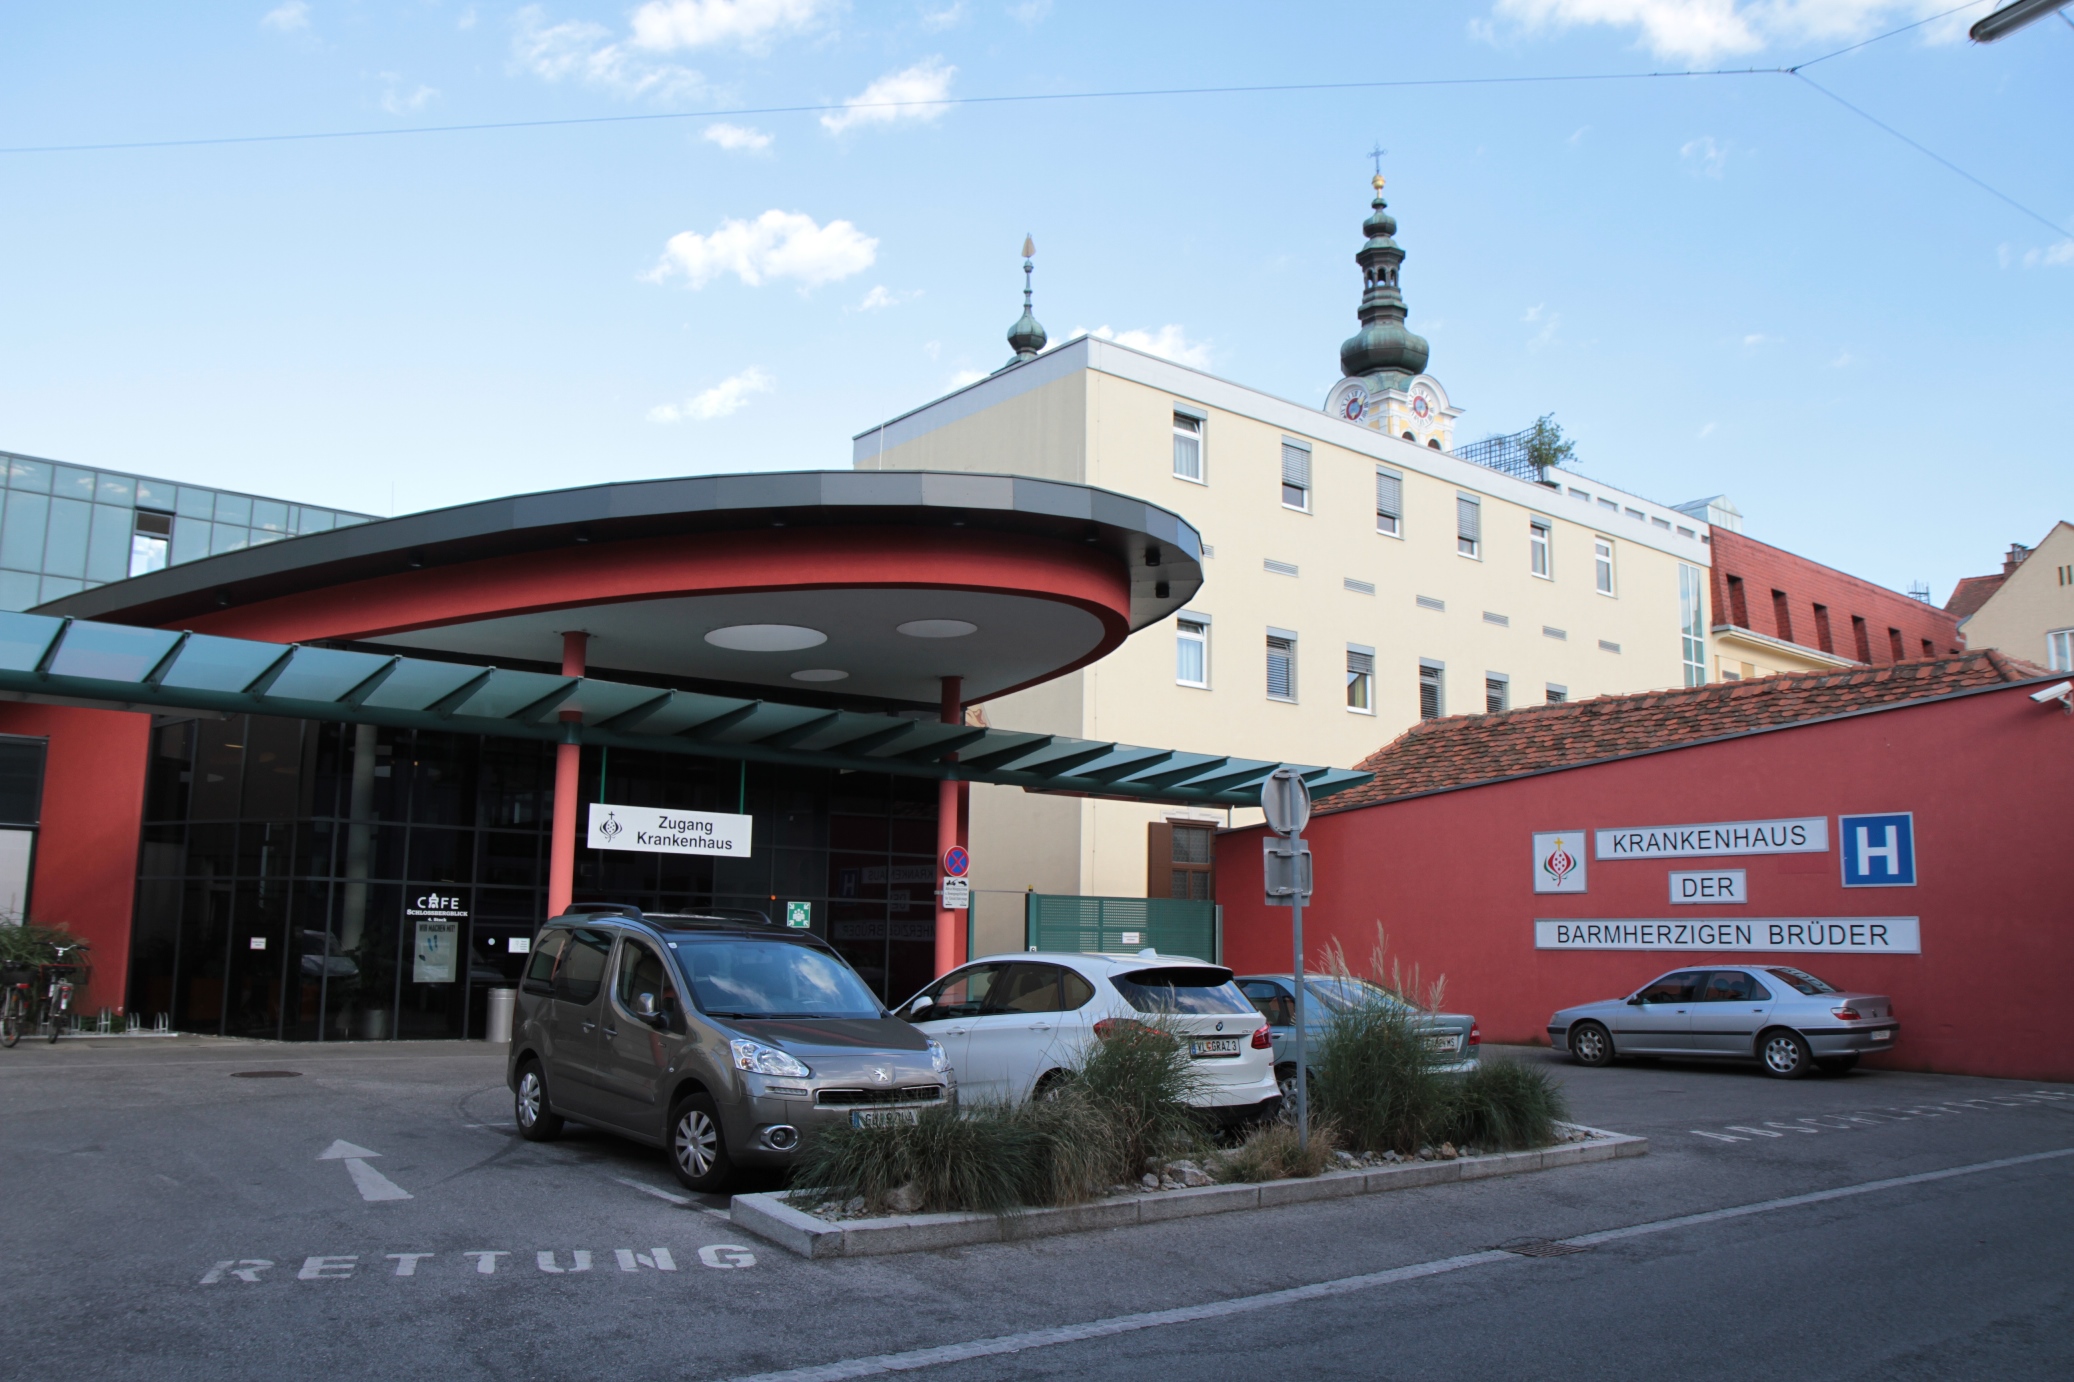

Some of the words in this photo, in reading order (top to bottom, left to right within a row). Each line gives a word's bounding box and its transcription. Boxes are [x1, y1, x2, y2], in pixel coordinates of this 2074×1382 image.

[658, 815, 714, 836] Zugang
[636, 831, 733, 850] Krankenhaus
[1613, 824, 1807, 853] KRANKENHAUS
[1856, 825, 1900, 876] H
[1682, 876, 1735, 898] DER
[428, 924, 446, 933] MACHEN
[1556, 923, 1753, 946] BARMHERZIGEN
[1769, 920, 1890, 947] BRÜDER
[1211, 1041, 1231, 1052] GRAZ
[1231, 1040, 1237, 1051] 3
[199, 1244, 758, 1285] RETTUNG
